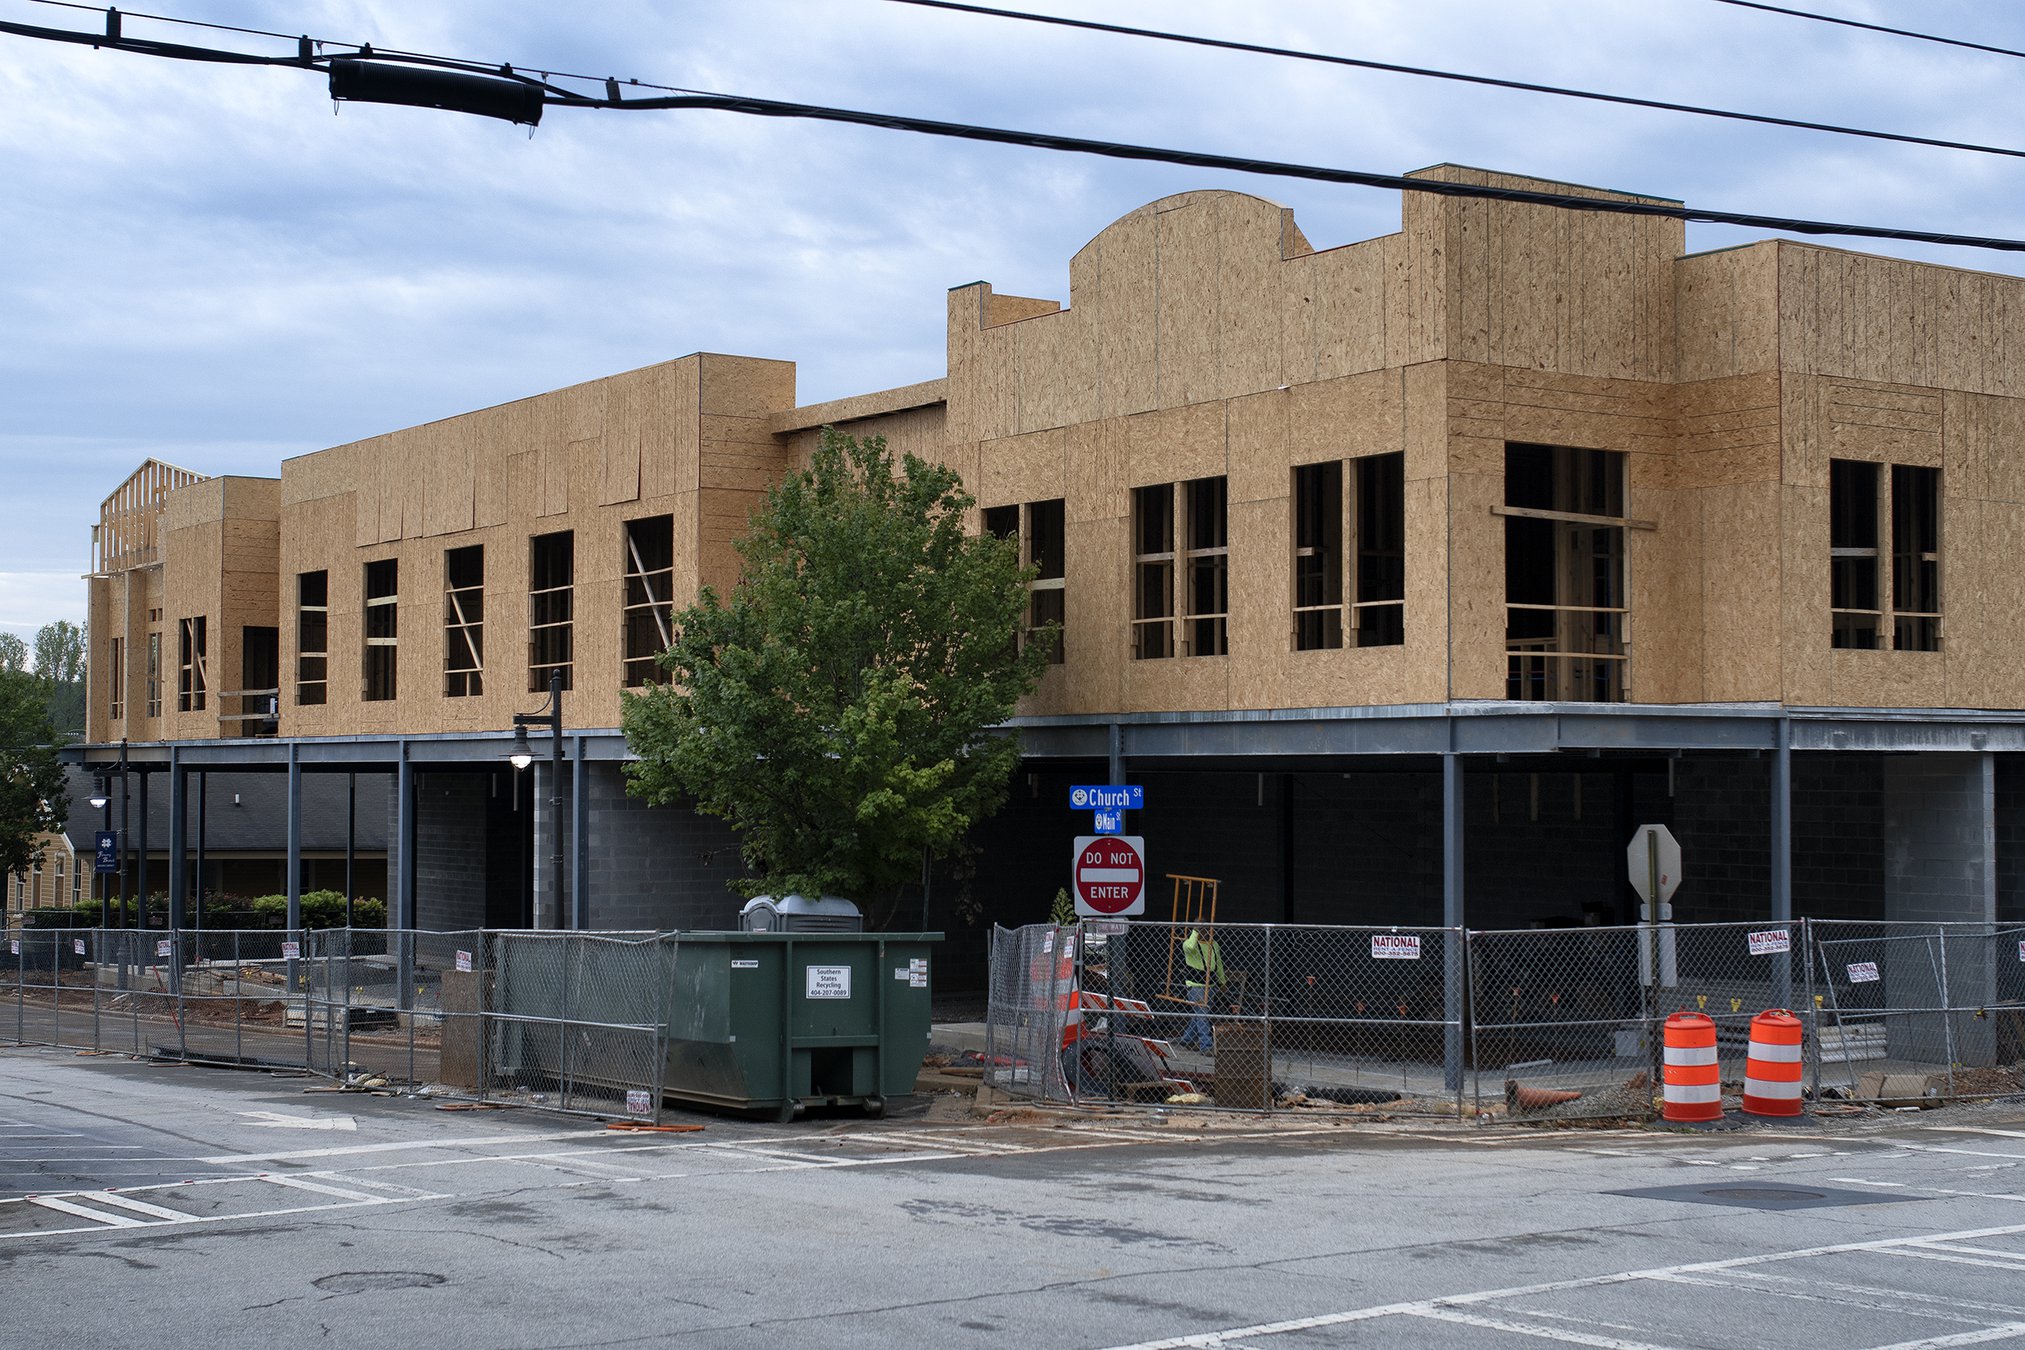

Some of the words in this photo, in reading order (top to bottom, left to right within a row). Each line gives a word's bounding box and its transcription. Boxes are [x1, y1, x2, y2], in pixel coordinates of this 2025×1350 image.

[1089, 788, 1130, 806] Church
[1133, 787, 1142, 798] St
[1102, 813, 1116, 831] Main
[1086, 852, 1102, 865] DO
[1110, 852, 1134, 865] NOT
[1090, 886, 1129, 899] ENTER
[1373, 936, 1419, 948] NATIONAL
[1750, 930, 1788, 945] NATIONAL
